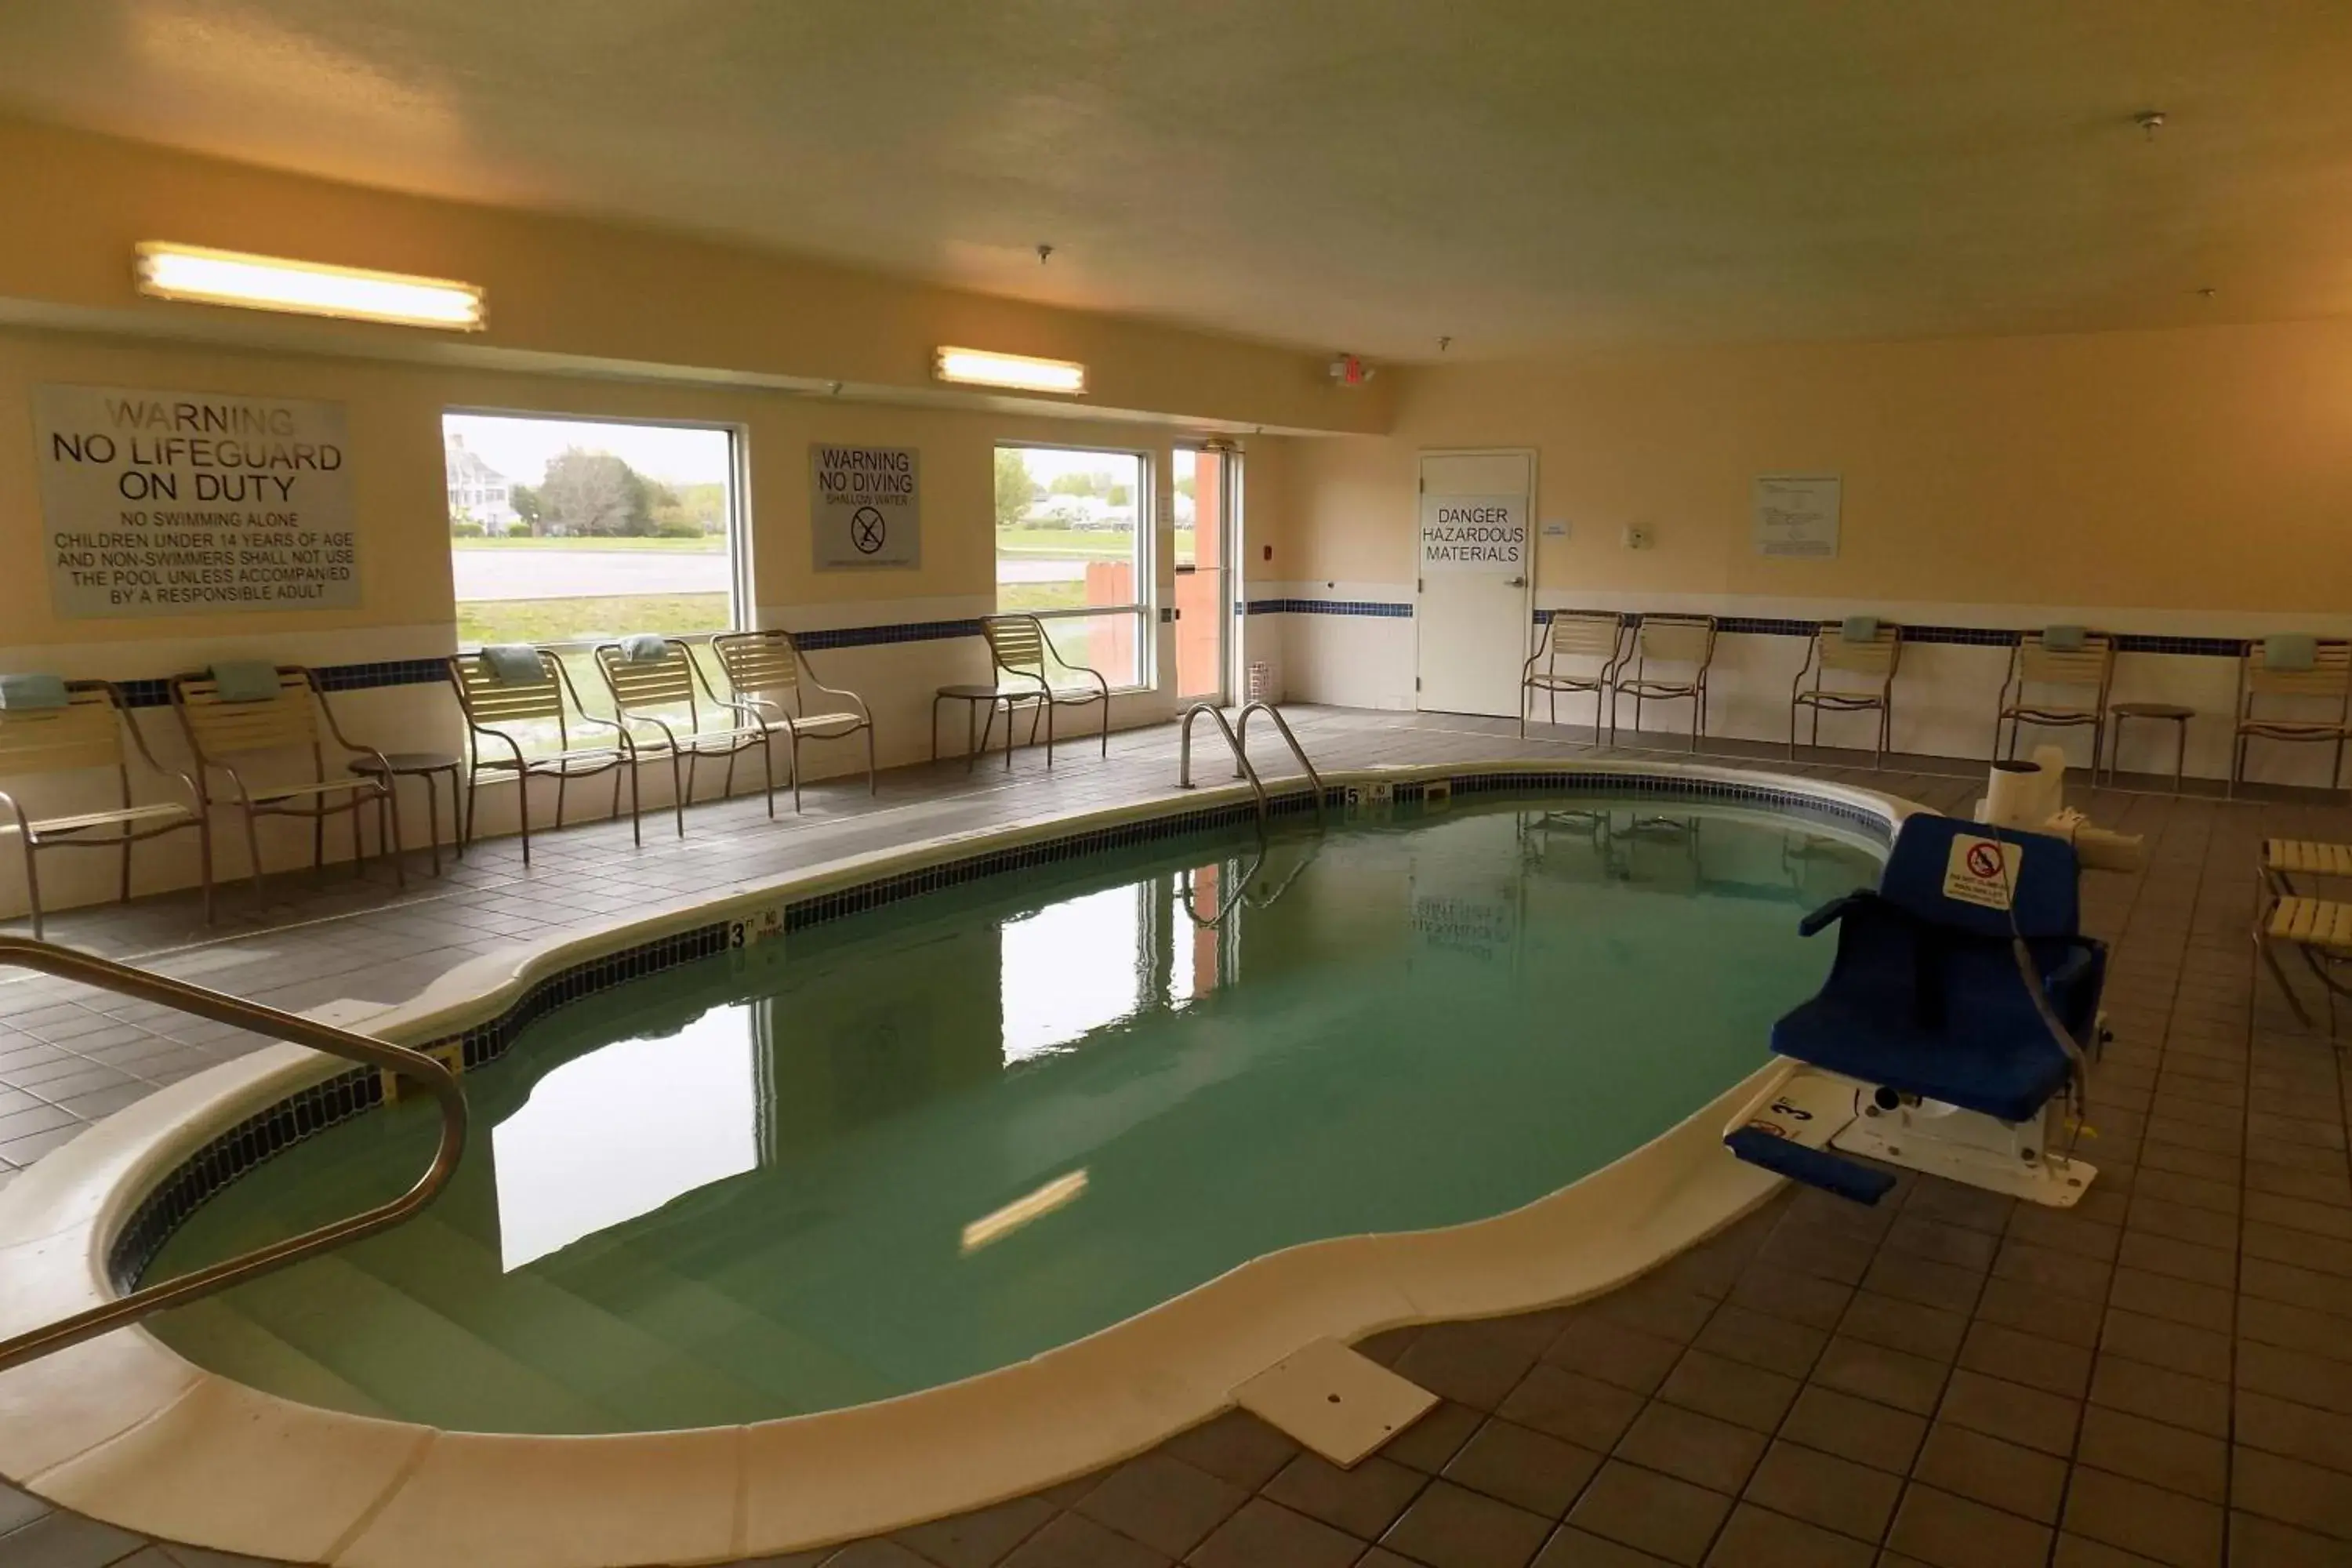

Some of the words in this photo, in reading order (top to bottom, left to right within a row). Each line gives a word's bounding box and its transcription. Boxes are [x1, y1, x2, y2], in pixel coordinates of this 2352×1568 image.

[104, 398, 293, 436] WARNING
[53, 432, 116, 463] NO
[130, 436, 342, 470] LIFEGUARD
[822, 449, 909, 472] WARNING
[119, 471, 177, 500] ON
[196, 474, 296, 503] DUTY
[819, 471, 847, 492] NO
[852, 473, 913, 493] DIVING
[876, 495, 909, 506] WATER
[120, 511, 147, 526] NO
[154, 511, 242, 528] SWIMMING
[246, 512, 299, 528] ALONE
[1438, 509, 1508, 524] DANGER
[54, 532, 149, 548] CHILDREN
[154, 533, 214, 547] UNDER
[220, 534, 237, 546] 14
[241, 533, 294, 547] YEARS
[298, 532, 320, 546] OF
[323, 532, 354, 546] AGE
[1423, 527, 1524, 543] HAZARDOUS
[57, 552, 95, 567] AND
[101, 551, 234, 567] NON-SWIMMERS
[240, 550, 288, 565] SHALL
[292, 549, 321, 564] NOT
[325, 549, 354, 564] USE
[1426, 546, 1519, 562] MATERIALS
[72, 571, 108, 586] THE
[114, 570, 163, 586] POOL
[168, 568, 234, 584] UNLESS
[238, 566, 350, 583] ACCOMPANIED
[111, 590, 134, 604] BY
[140, 590, 152, 603] A
[157, 586, 273, 603] RESPONSIBLE
[277, 584, 325, 599] ADULT
[731, 923, 745, 949] 3
[1771, 1104, 1813, 1120] 3
